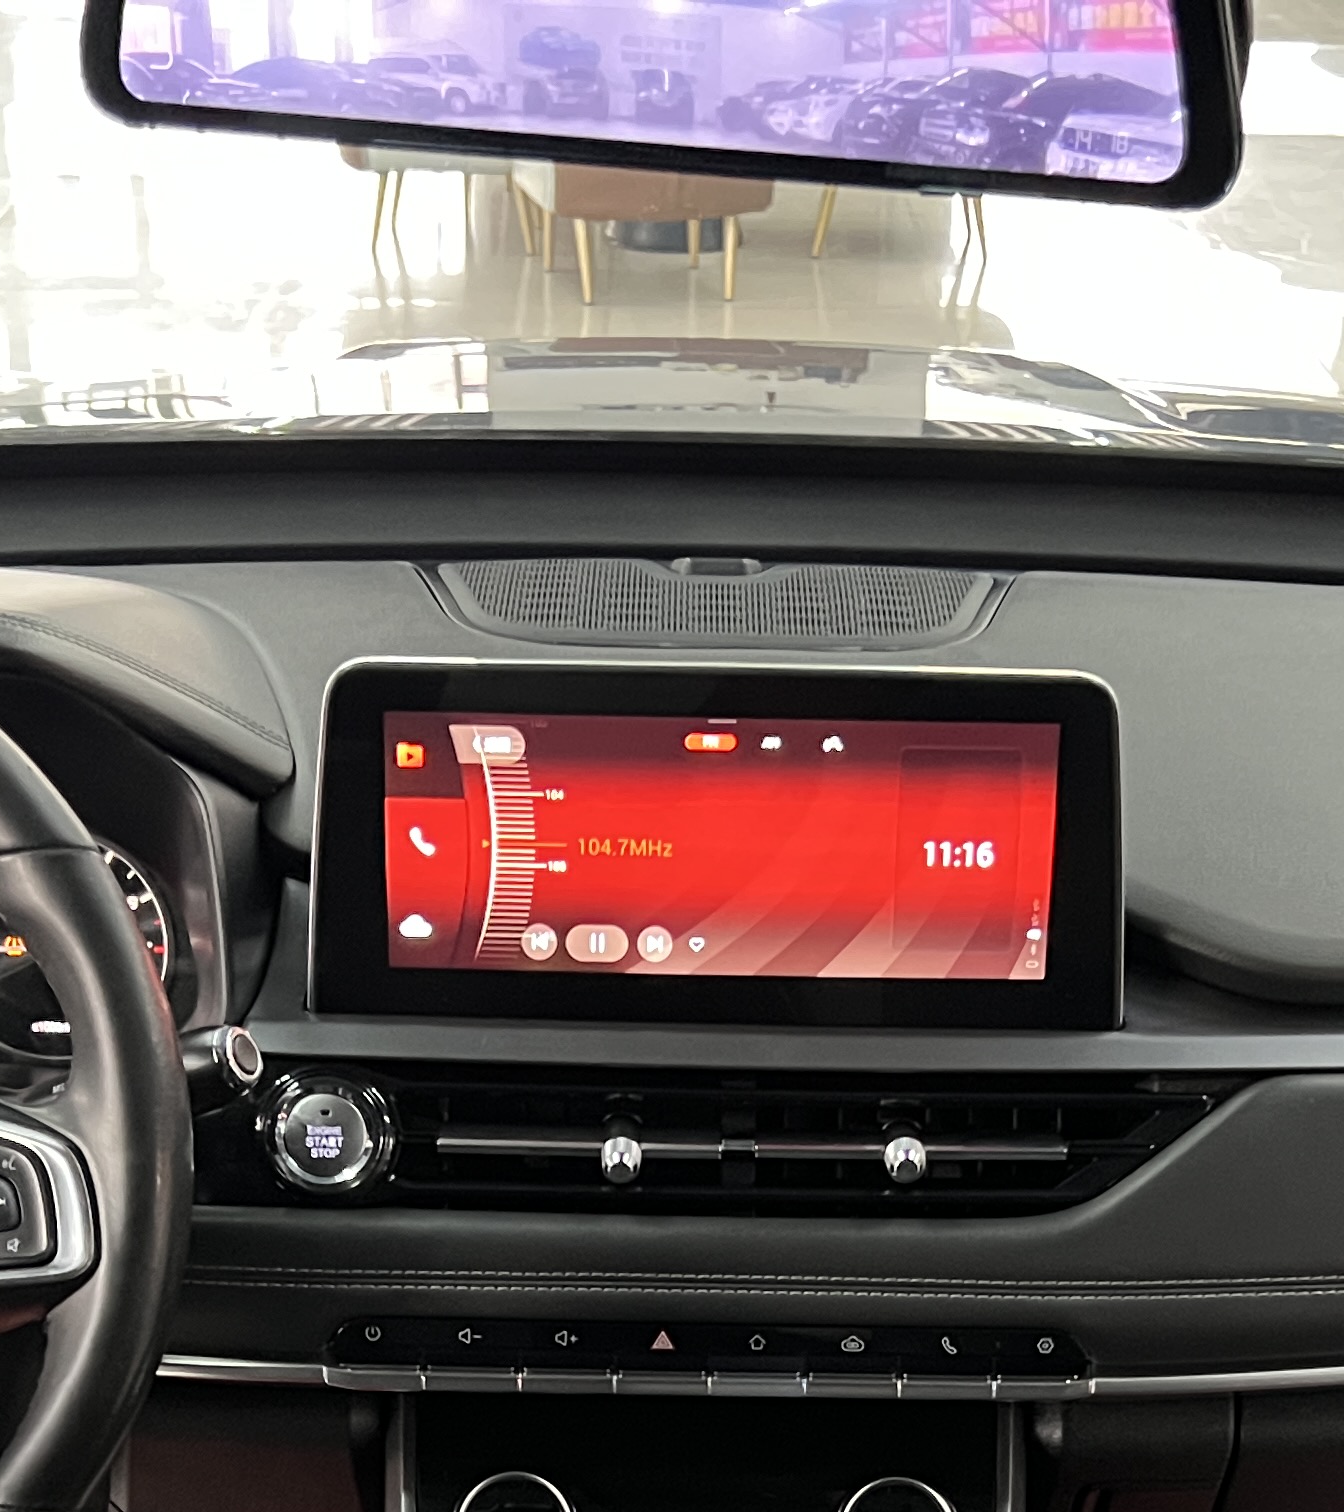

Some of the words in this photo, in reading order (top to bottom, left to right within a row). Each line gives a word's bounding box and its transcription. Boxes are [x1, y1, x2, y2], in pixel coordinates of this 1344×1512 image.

[577, 837, 673, 858] 104.7MHz
[922, 840, 995, 869] 11:16
[305, 1136, 344, 1148] START
[310, 1147, 341, 1159] STOP
